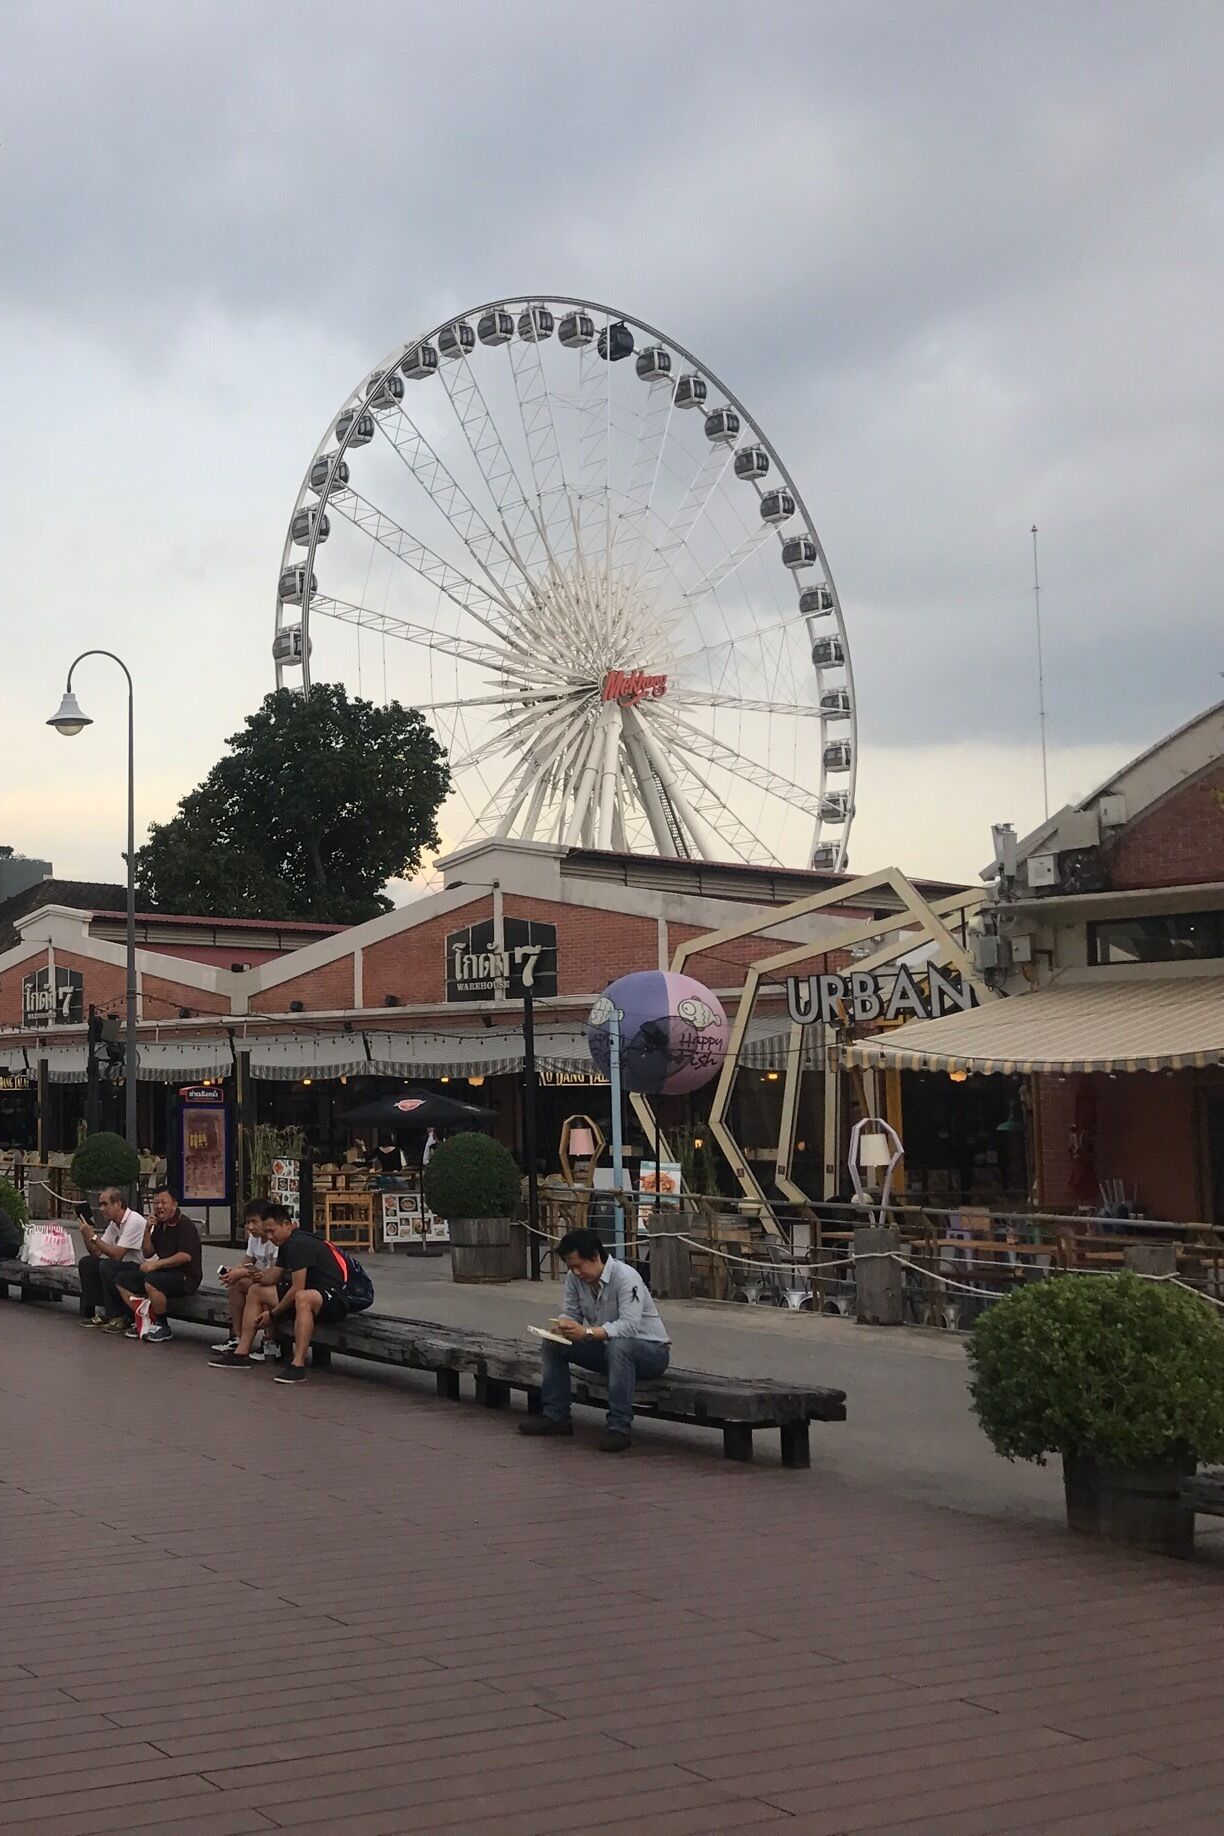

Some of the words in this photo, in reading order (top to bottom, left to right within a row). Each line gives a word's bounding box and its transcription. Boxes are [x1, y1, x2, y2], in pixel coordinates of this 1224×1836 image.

[452, 942, 510, 981] โกดัง
[514, 945, 542, 988] 7
[59, 986, 75, 1017] 7
[457, 981, 510, 991] WAREHOUSE
[786, 960, 981, 1025] URBAN
[679, 1032, 723, 1052] Happy
